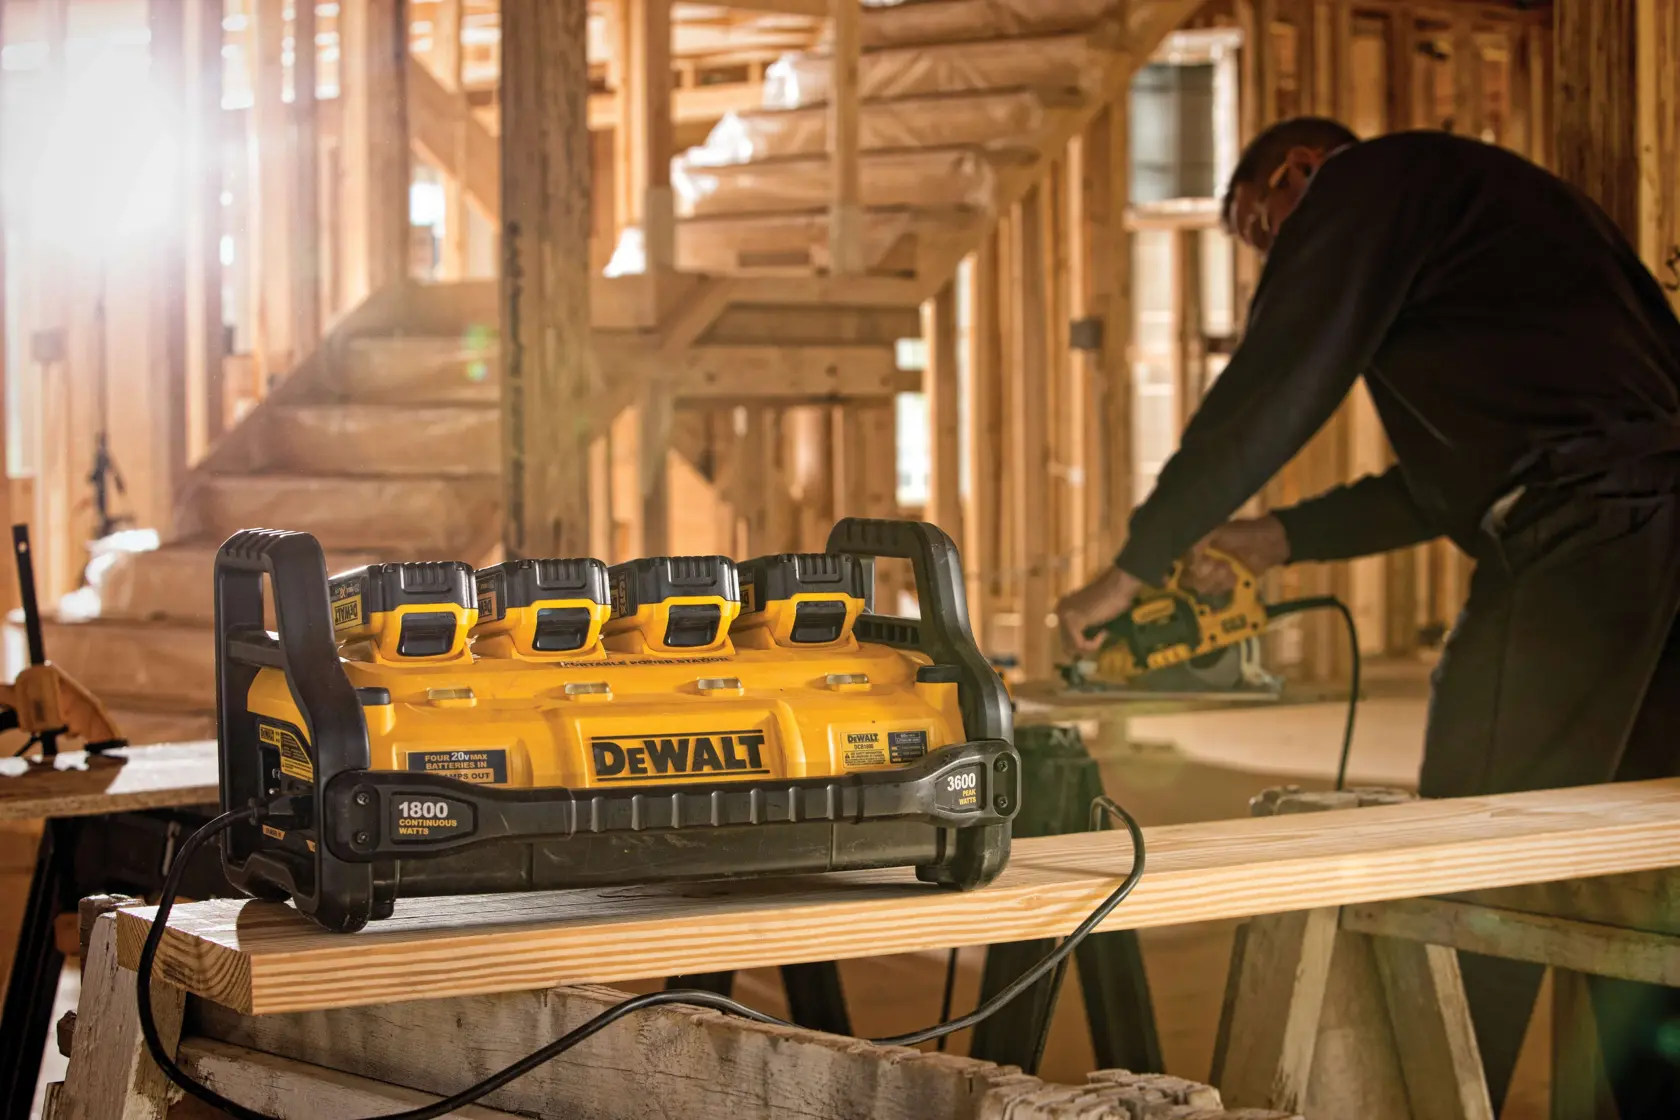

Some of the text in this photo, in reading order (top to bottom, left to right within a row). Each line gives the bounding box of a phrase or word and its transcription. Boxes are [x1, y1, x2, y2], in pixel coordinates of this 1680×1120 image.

[847, 733, 879, 744] DEWALT
[592, 735, 765, 776] DEWALT
[425, 762, 475, 770] BATTERIES
[947, 772, 977, 791] 3600
[962, 789, 977, 797] PEAK
[959, 796, 977, 805] WATTS
[398, 801, 448, 818] 1800
[399, 818, 457, 827] CONTINUOUS
[399, 827, 429, 835] WATTS
